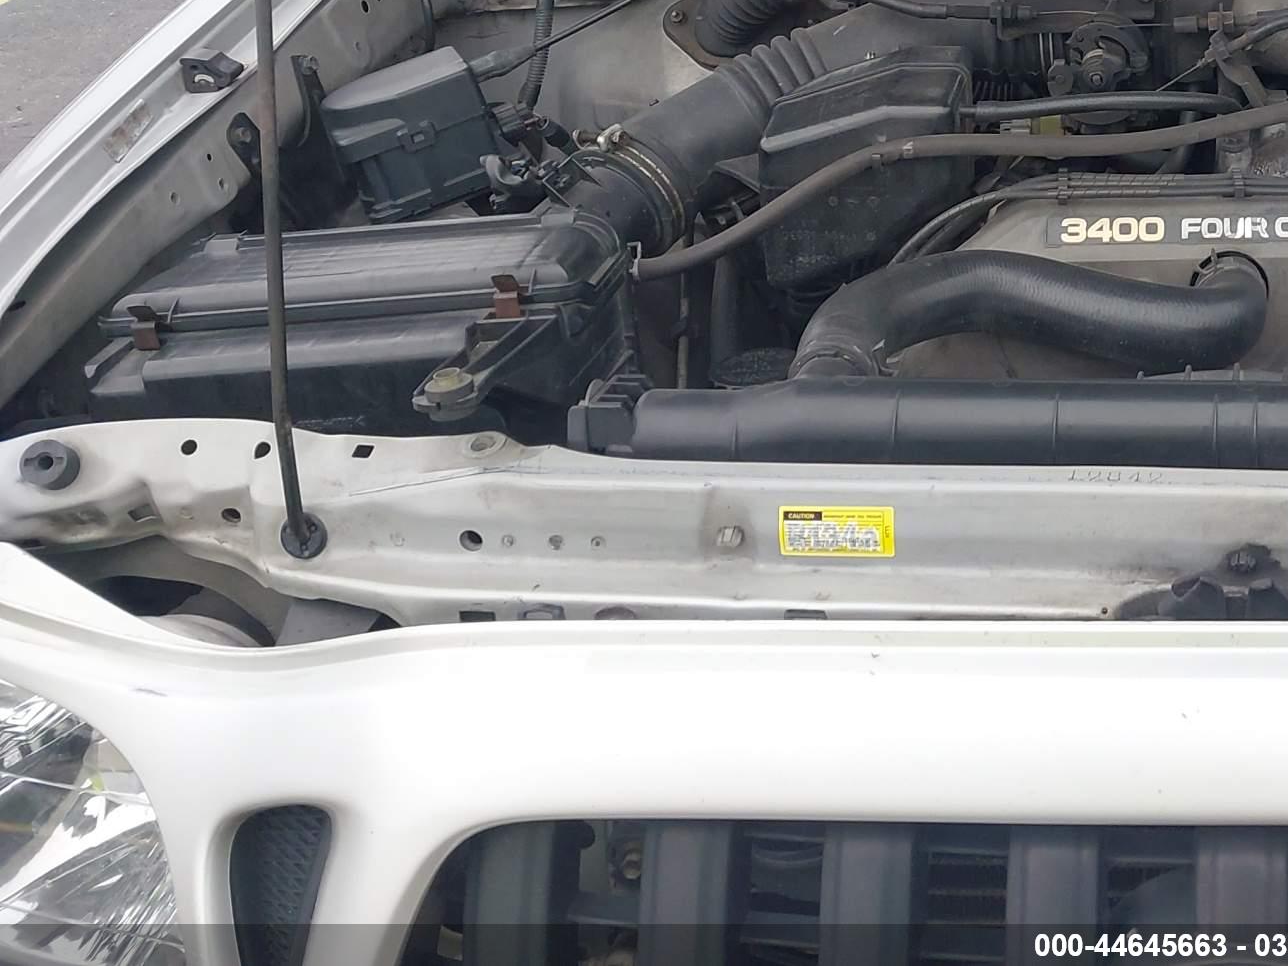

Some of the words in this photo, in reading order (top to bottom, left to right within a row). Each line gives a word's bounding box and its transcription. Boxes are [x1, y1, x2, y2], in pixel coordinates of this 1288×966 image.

[1060, 216, 1166, 243] 3400
[1181, 217, 1270, 240] FOUR
[788, 512, 815, 520] CAUTION
